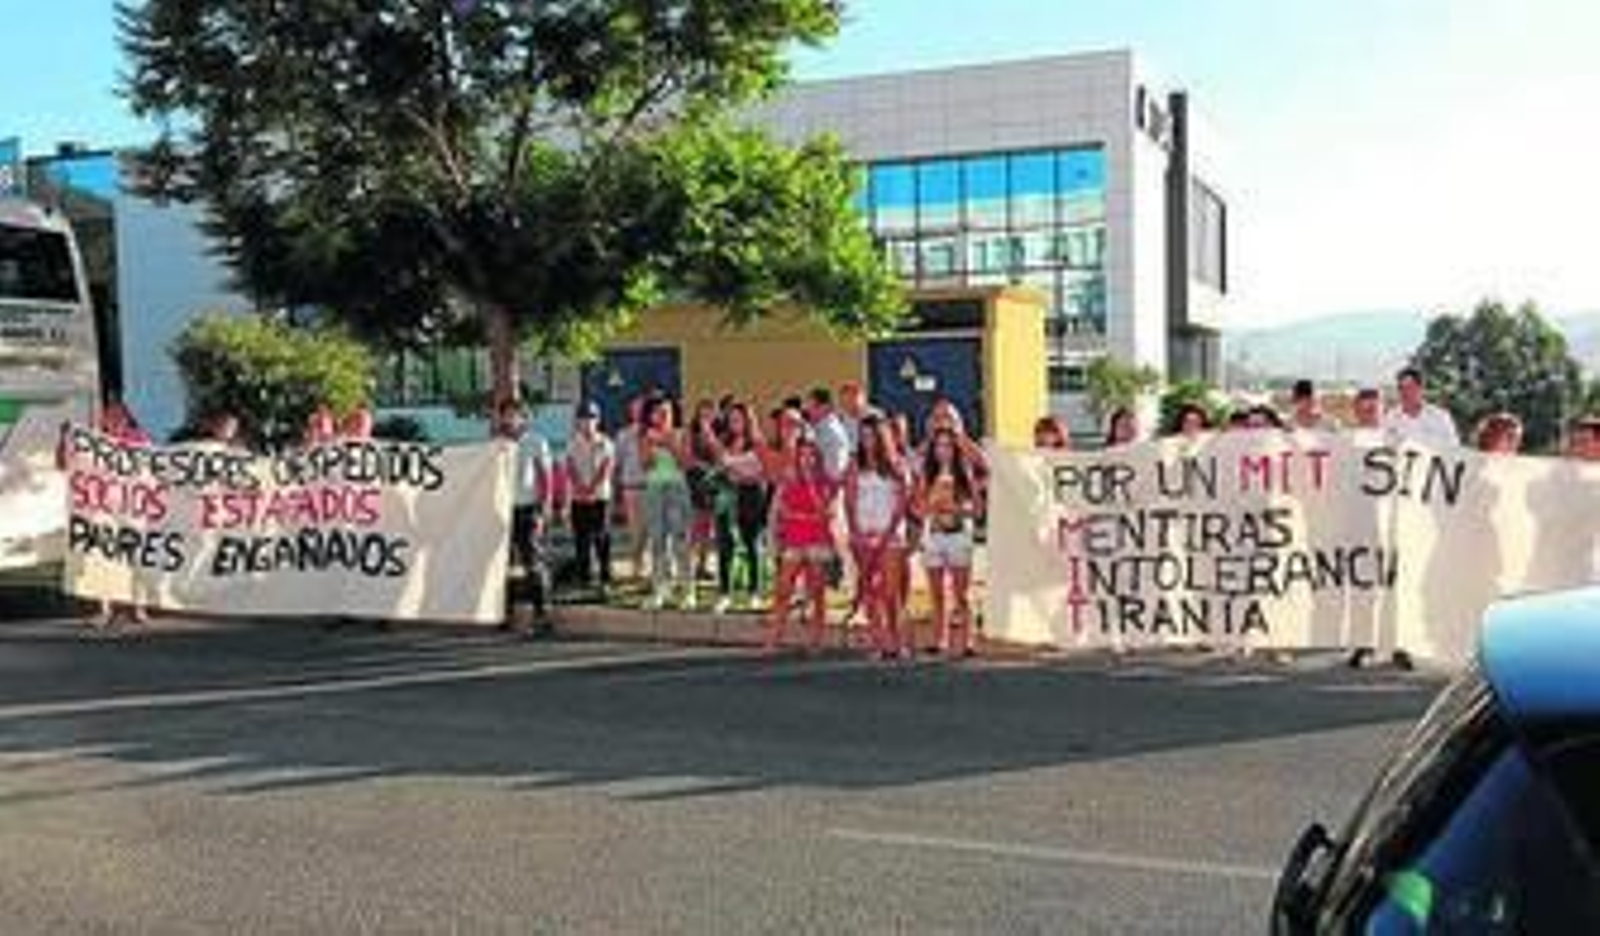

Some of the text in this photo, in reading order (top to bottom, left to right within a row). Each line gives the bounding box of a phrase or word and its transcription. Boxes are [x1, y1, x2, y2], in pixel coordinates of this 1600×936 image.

[70, 471, 167, 521] SOCIOS
[1053, 447, 1466, 506] POR UN MIT SIN
[69, 513, 408, 577] PADRES ENGAÑADOS
[1057, 508, 1293, 556] MENTIRAS
